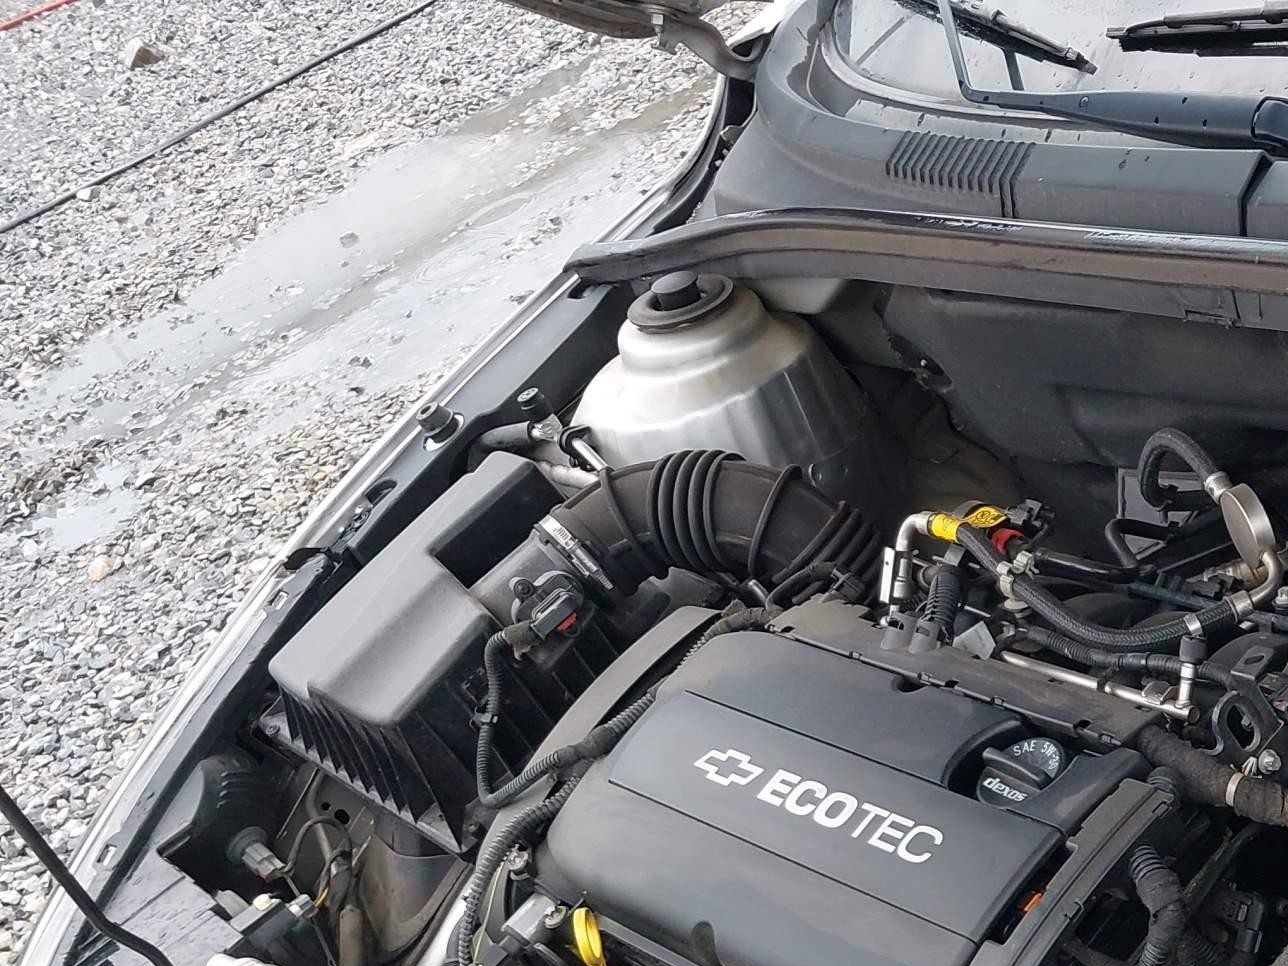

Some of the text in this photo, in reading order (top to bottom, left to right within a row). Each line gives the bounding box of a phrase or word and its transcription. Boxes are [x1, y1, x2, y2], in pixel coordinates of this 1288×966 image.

[1012, 739, 1038, 757] SAE
[982, 776, 1028, 802] dexos
[756, 768, 944, 864] ECOTEC
